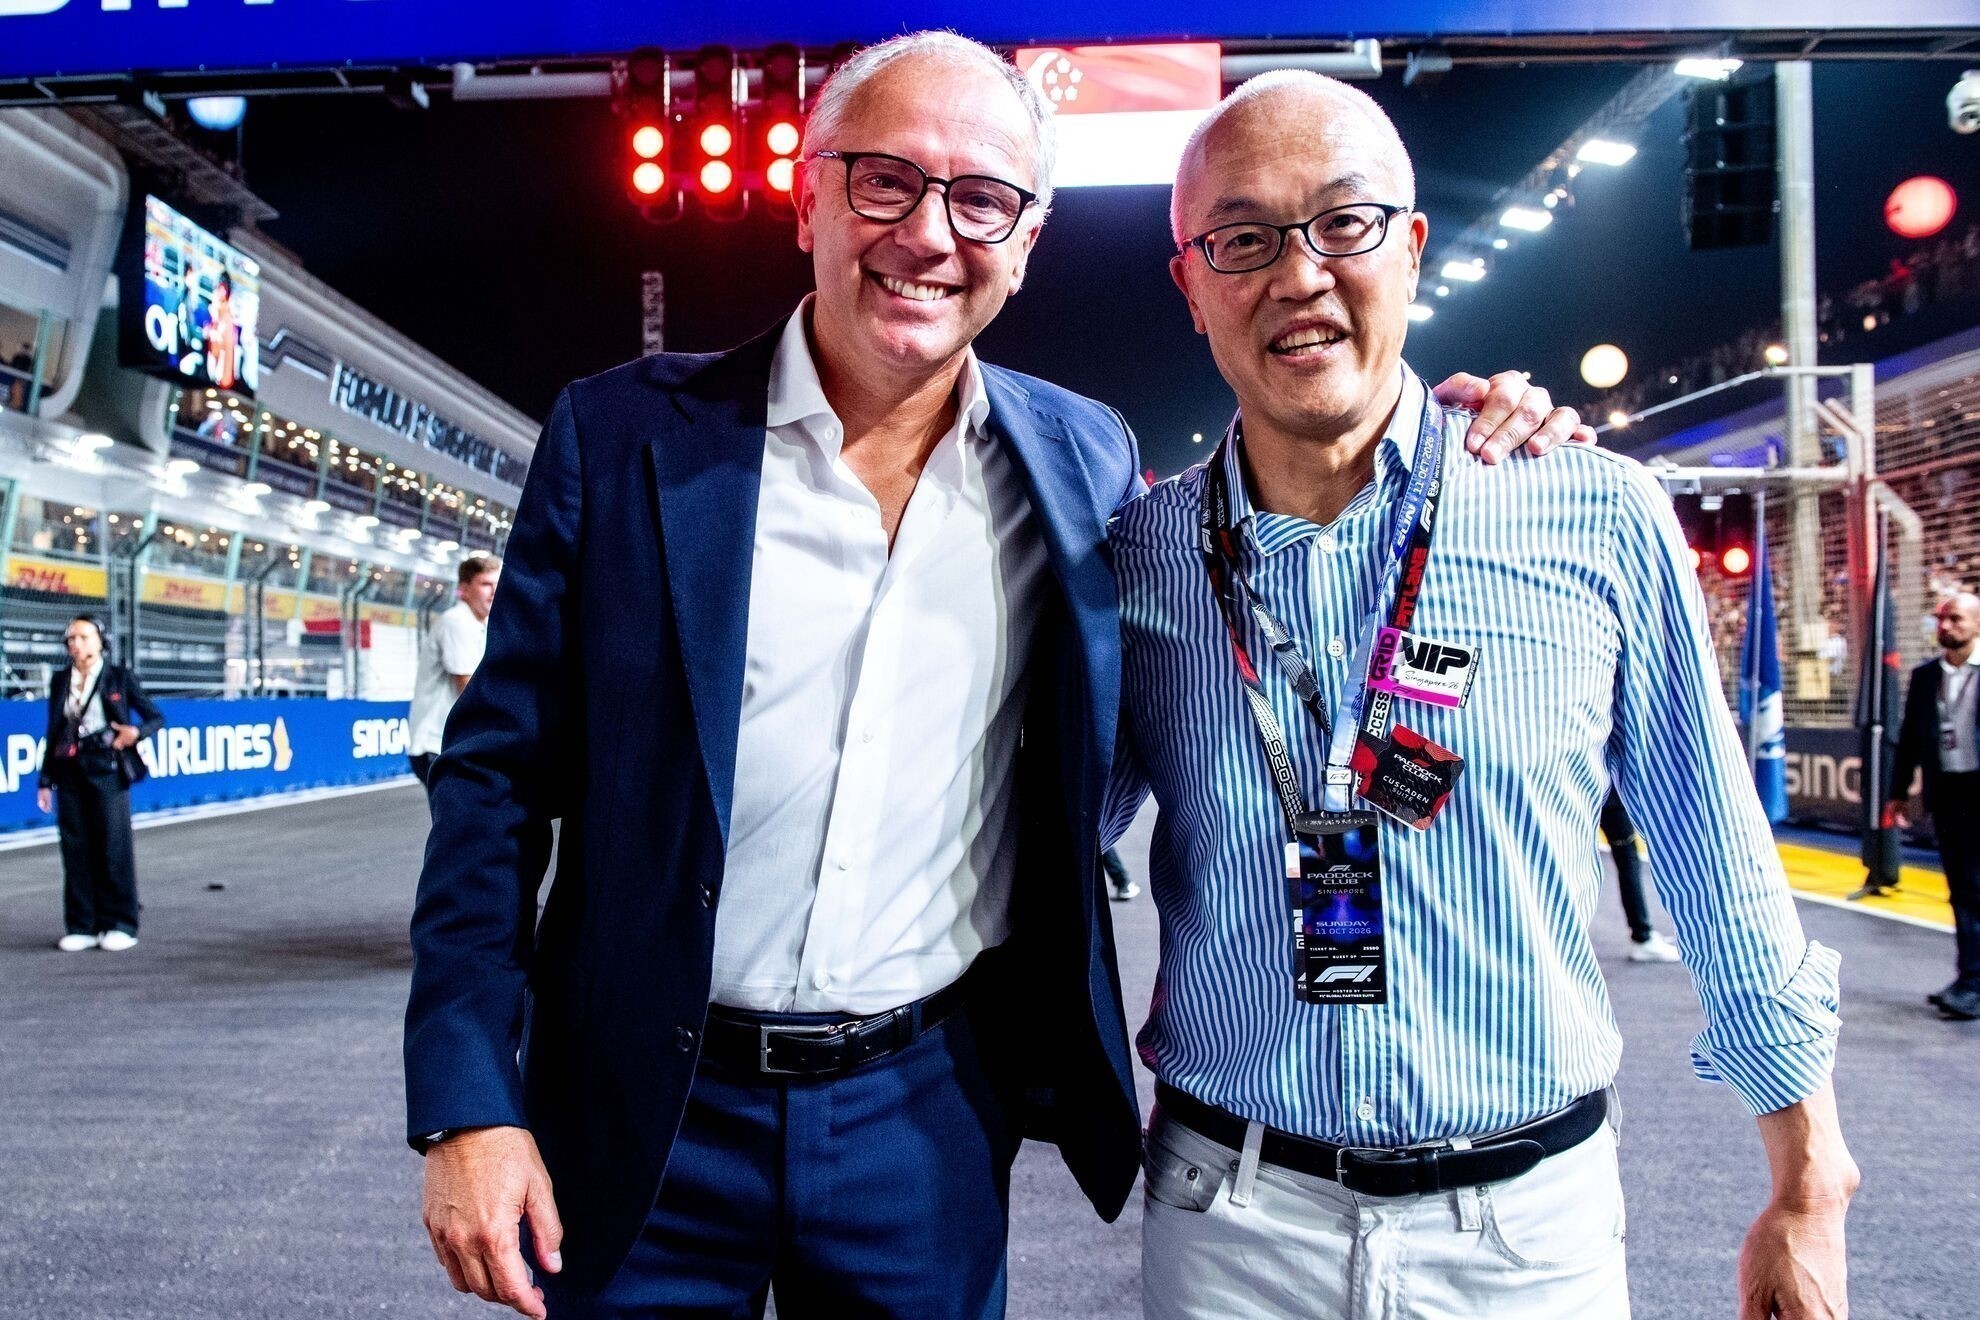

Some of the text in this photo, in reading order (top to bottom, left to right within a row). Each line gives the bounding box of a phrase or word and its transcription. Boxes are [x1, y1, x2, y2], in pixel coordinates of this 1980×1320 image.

[1397, 436, 1435, 547] SUN 11 OCT 2026
[1420, 498, 1435, 533] F1
[18, 567, 69, 594] DHL
[1396, 598, 1416, 628] PIT
[1371, 633, 1396, 681] GRID
[1401, 635, 1471, 676] VIP
[1404, 671, 1459, 690] Singapore 26
[1369, 691, 1390, 738] CCESS
[138, 723, 272, 779] AIRLINES
[352, 718, 409, 759] SINGA
[1270, 739, 1296, 797] 2026
[1393, 753, 1443, 785] PADDOCK
[1402, 764, 1429, 782] CLUB
[1785, 752, 1863, 804] SING
[1382, 775, 1430, 804] CUSCADEN
[1391, 787, 1414, 802] SUITE
[1306, 871, 1373, 879] PADDOCK
[1328, 864, 1351, 872] F1
[1315, 920, 1370, 928] SUNDAY
[1349, 927, 1372, 935] 2026
[1313, 964, 1379, 983] F1
